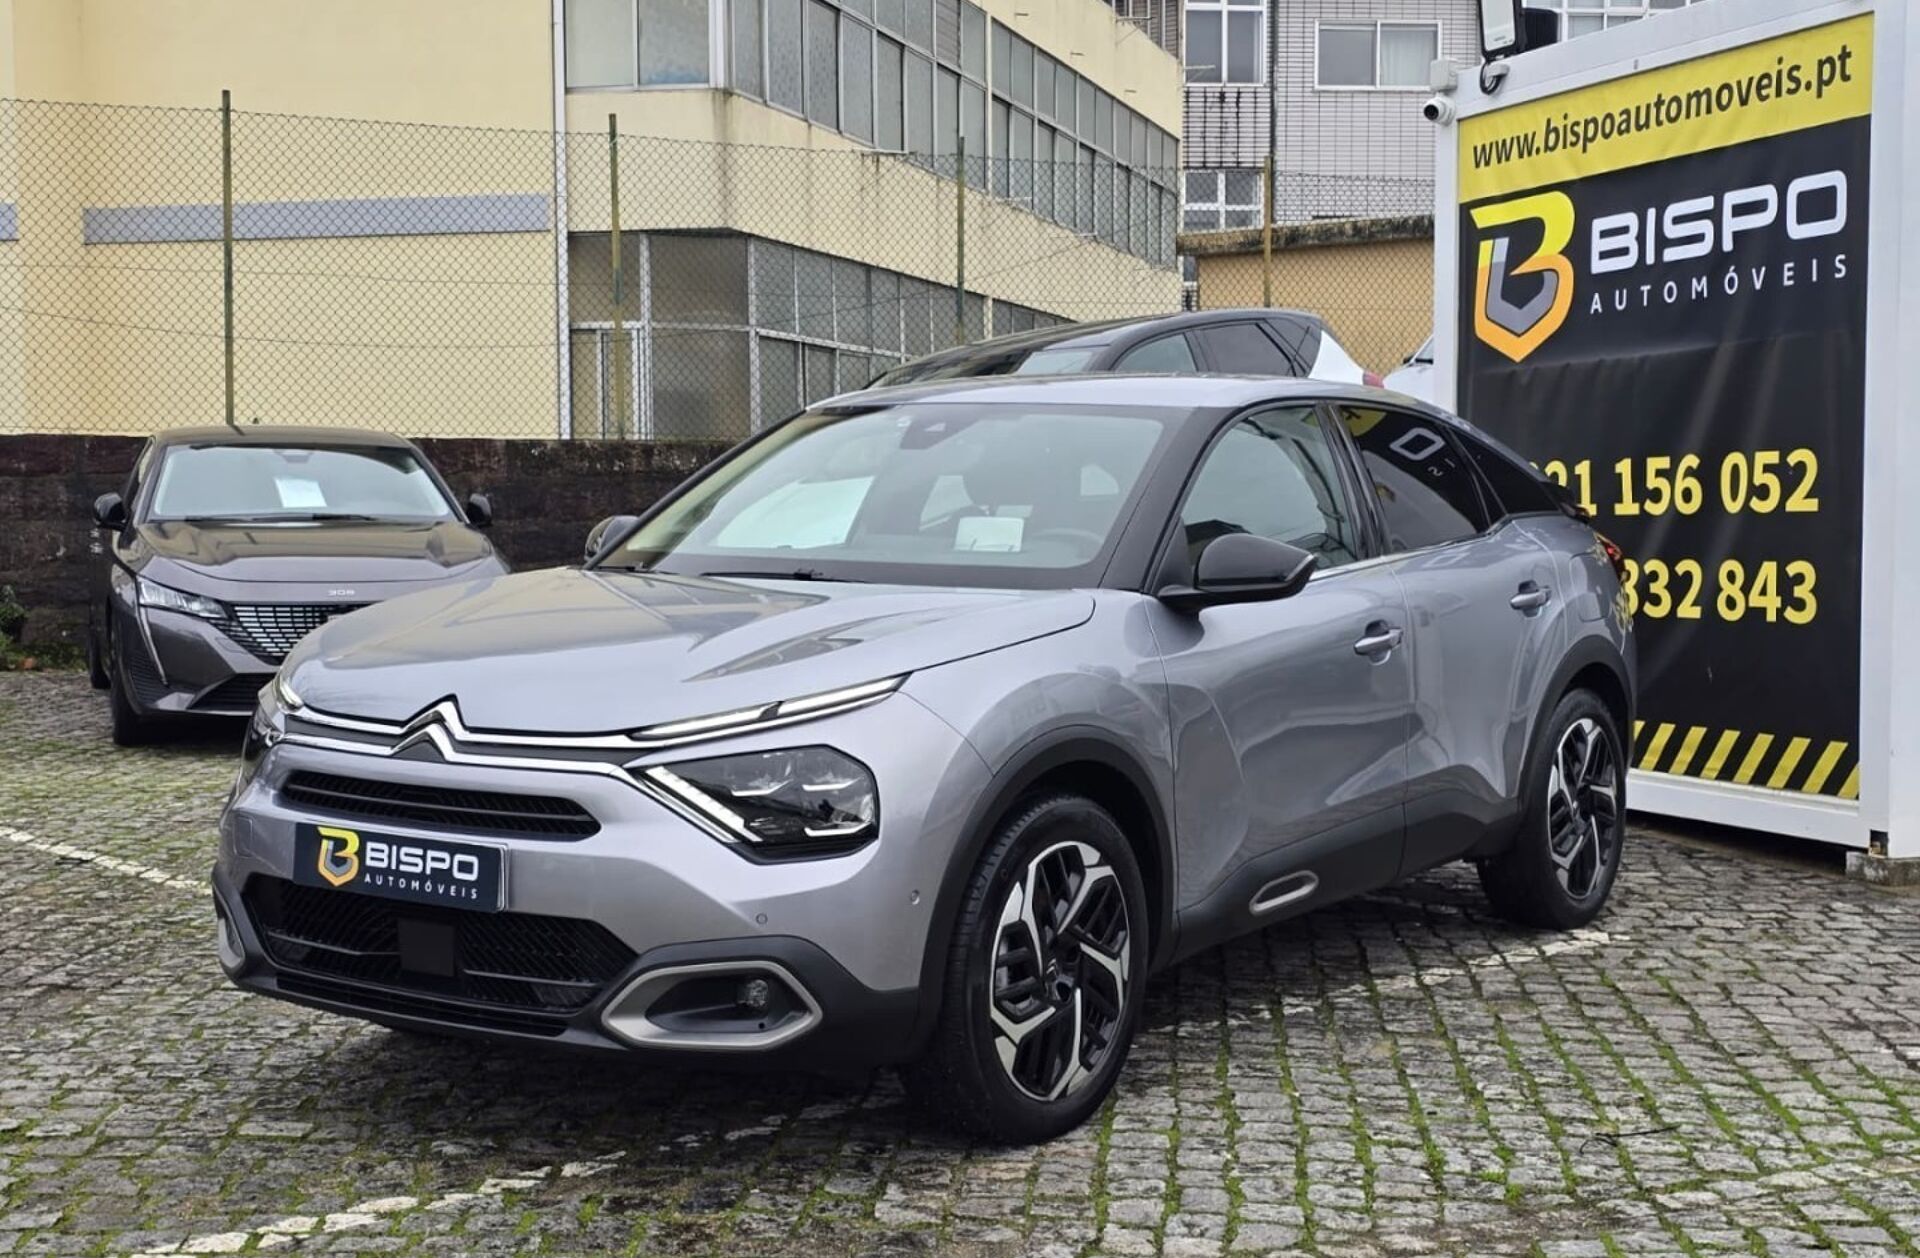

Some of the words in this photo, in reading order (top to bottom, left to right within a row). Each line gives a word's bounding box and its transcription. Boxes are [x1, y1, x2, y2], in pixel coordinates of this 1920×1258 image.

[1472, 44, 1852, 169] www.bispoautomoveis.pt
[1590, 169, 1848, 275] BISPO
[1590, 254, 1847, 314] AUTOMÓVEIS
[1613, 453, 1703, 517] 156
[1720, 448, 1819, 514] 052
[1716, 558, 1818, 625] 843
[365, 841, 479, 882] BISPO
[365, 873, 478, 900] AUTOMÓVEIS
